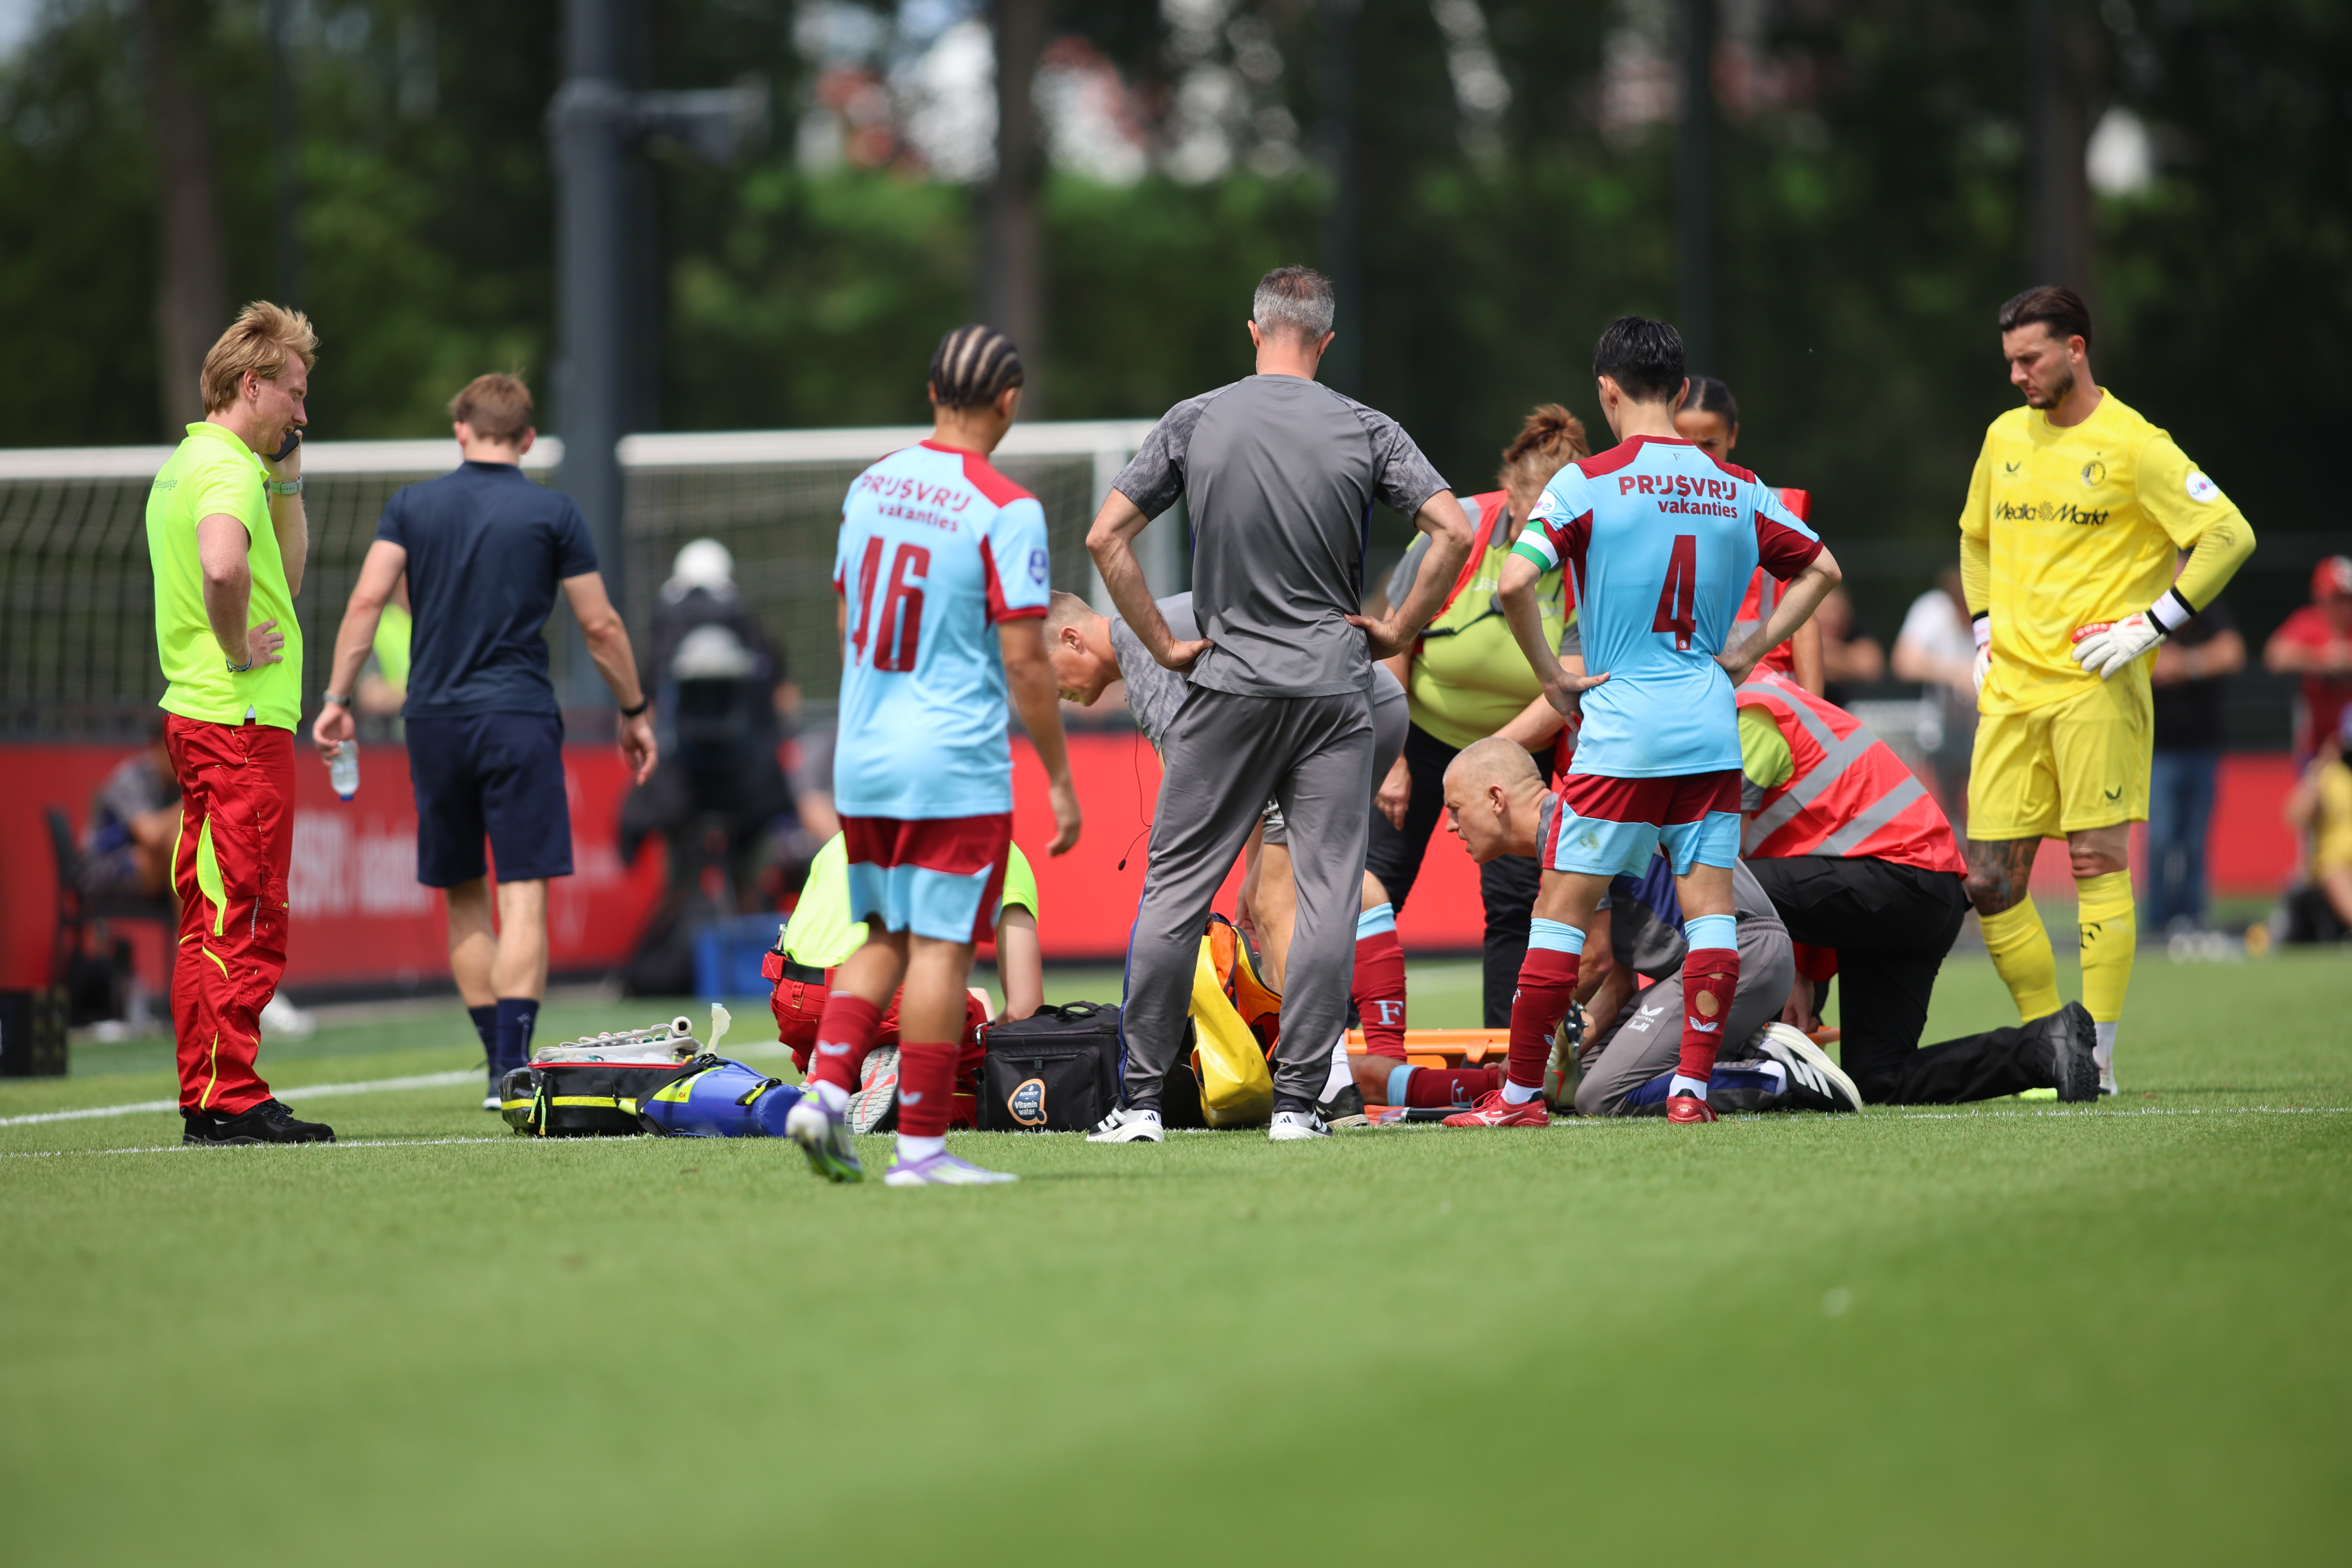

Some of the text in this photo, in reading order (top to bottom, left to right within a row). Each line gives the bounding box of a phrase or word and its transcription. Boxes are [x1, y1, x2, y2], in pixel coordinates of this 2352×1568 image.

[878, 504, 958, 532] vakanties
[1657, 498, 1737, 519] vakanties
[1994, 500, 2109, 526] Media Markt
[852, 535, 931, 673] 16
[1651, 535, 1697, 651] 4
[1374, 1000, 1404, 1025] F
[1014, 1100, 1038, 1109] Vitamin
